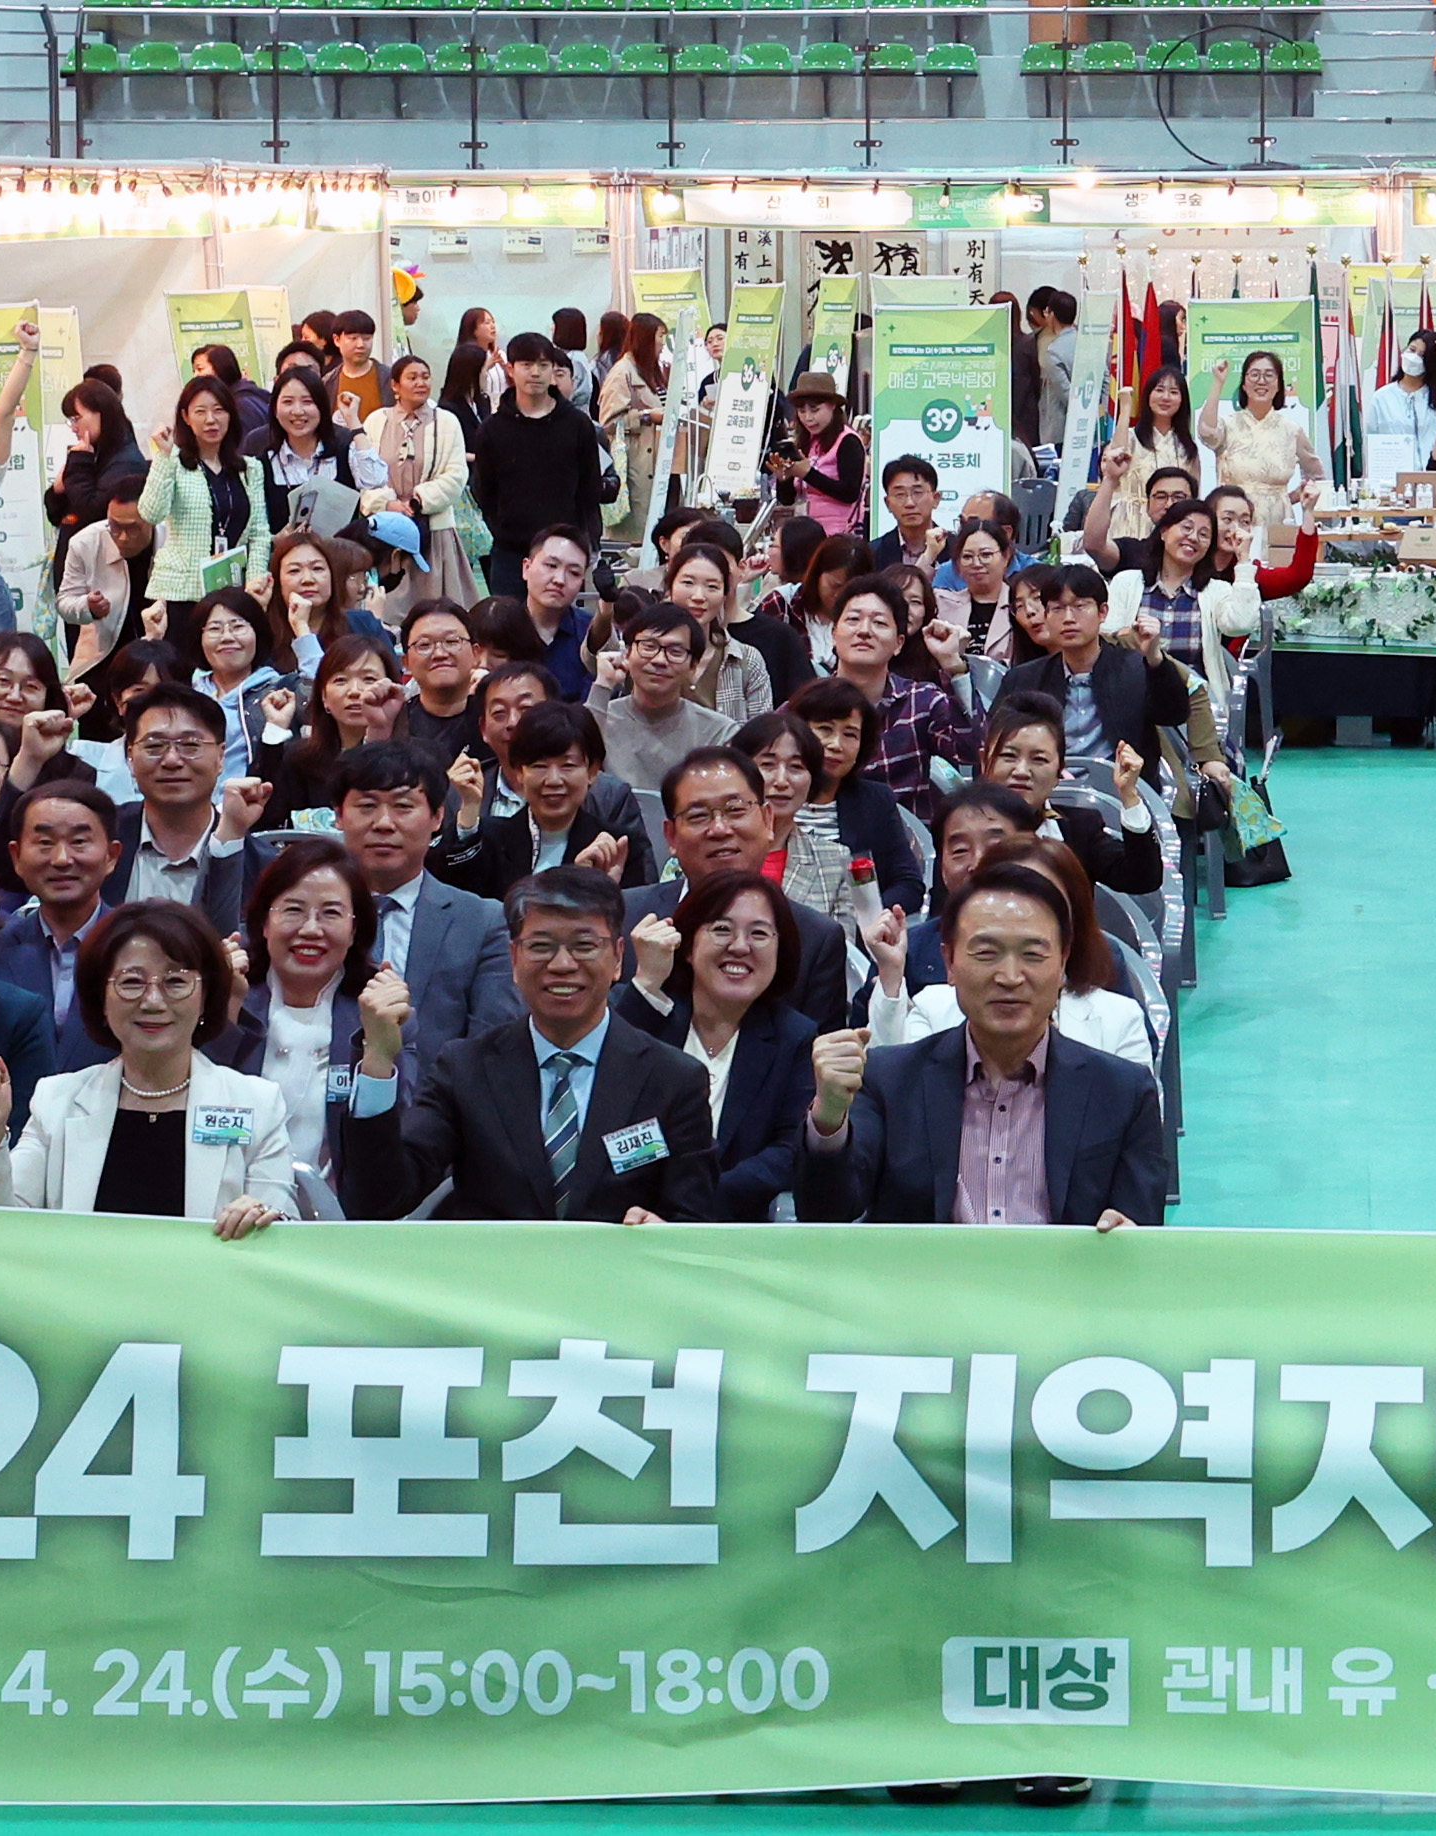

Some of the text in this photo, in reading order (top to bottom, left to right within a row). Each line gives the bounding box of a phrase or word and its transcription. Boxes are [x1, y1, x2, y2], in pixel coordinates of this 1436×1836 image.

[922, 371, 996, 389] 교육박람회
[926, 408, 958, 432] 39
[937, 453, 981, 468] 공동체
[335, 1073, 354, 1096] 이
[204, 1113, 245, 1132] 원순자
[615, 1130, 654, 1157] 김재진
[260, 1338, 725, 1566] 포천
[0, 1647, 69, 1719] 4.
[92, 1644, 343, 1722] 24.(수)
[365, 1645, 830, 1718] 15:00~18:00
[971, 1645, 1115, 1714] 대상
[1162, 1646, 1304, 1716] 관내
